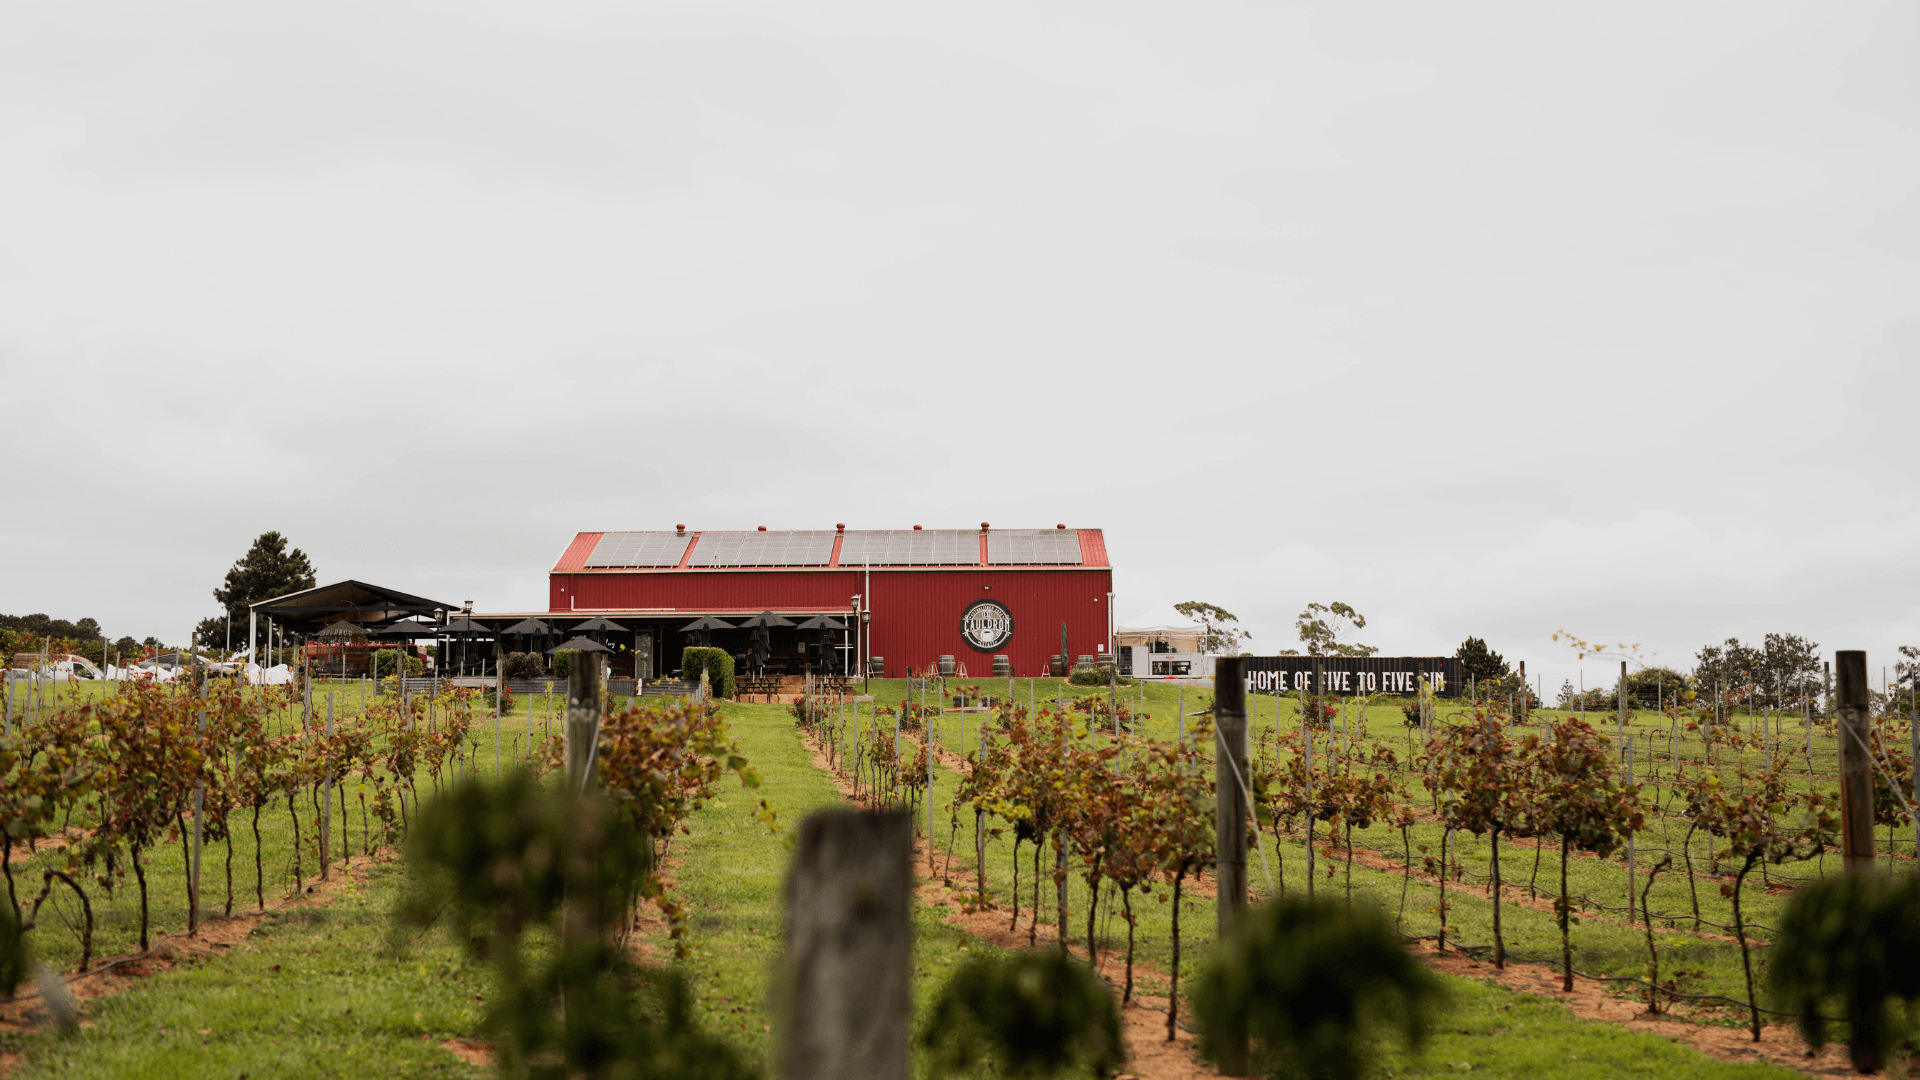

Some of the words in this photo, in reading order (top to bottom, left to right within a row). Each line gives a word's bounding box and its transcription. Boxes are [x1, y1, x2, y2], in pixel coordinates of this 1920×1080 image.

[964, 619, 1010, 632] CAULDRON
[1247, 670, 1288, 691] HOME
[1294, 671, 1313, 691] OF
[1356, 671, 1376, 691] TO
[1382, 671, 1415, 691] FIVE
